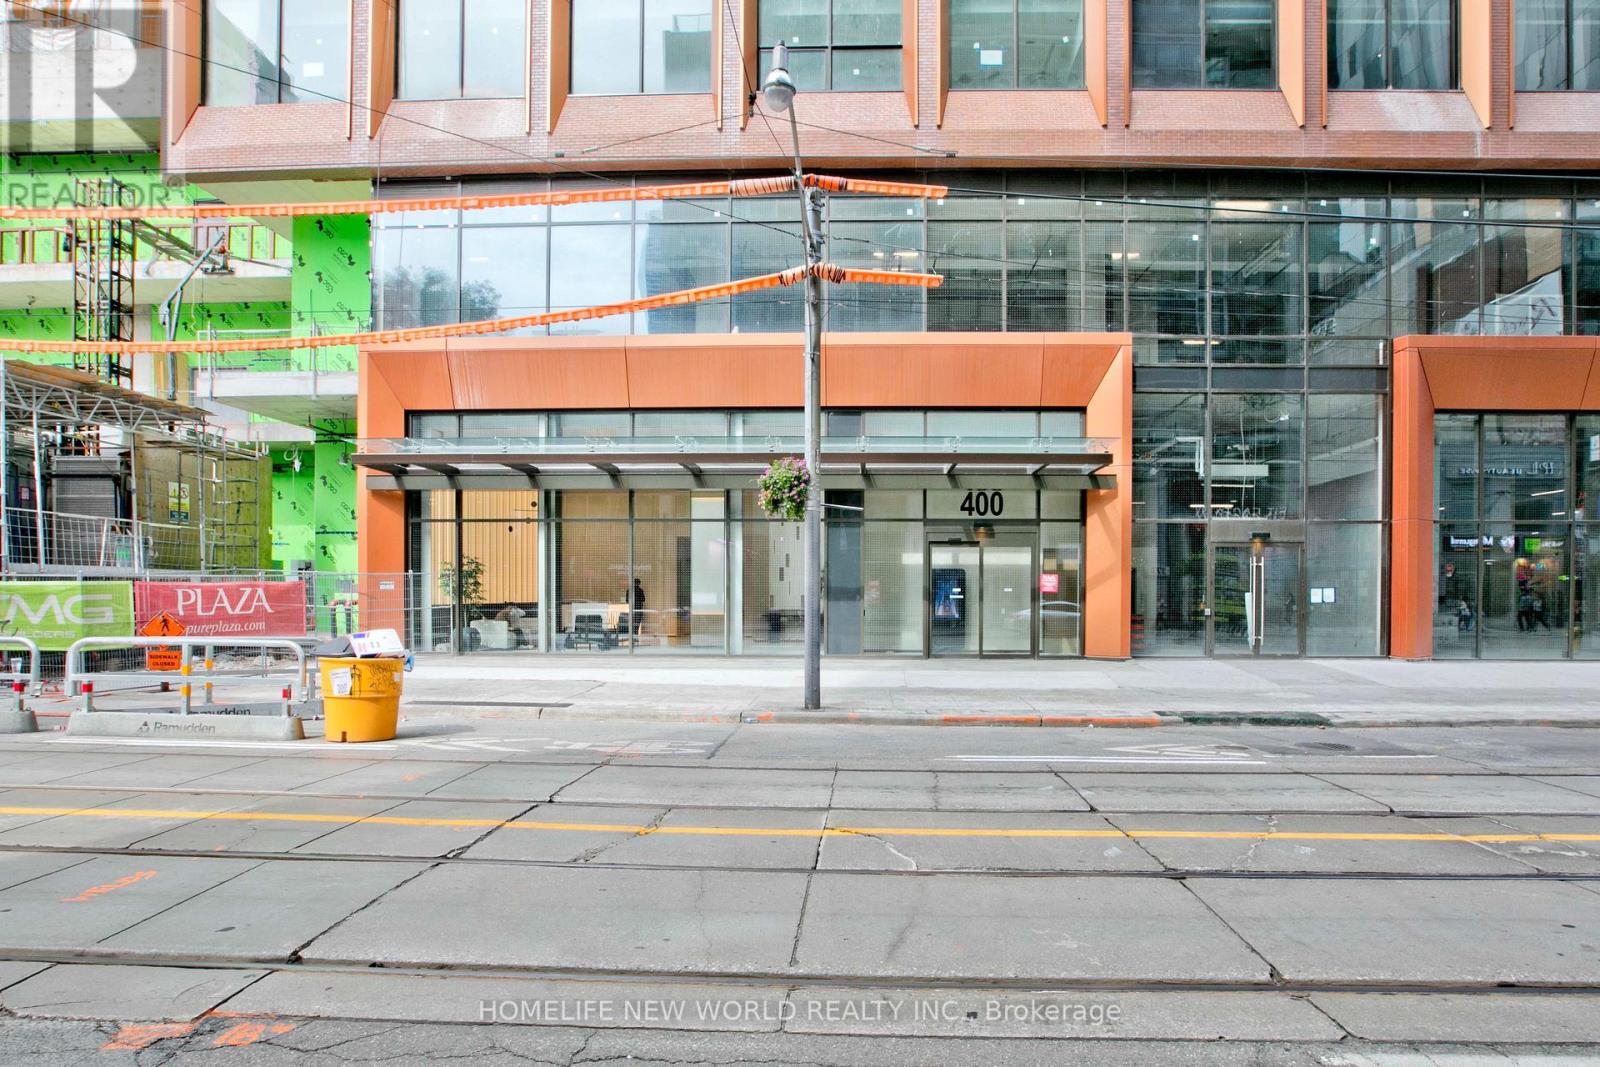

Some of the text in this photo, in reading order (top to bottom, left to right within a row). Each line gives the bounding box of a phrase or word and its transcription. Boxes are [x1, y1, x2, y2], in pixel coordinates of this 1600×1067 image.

[960, 491, 1004, 516] 400
[175, 587, 275, 616] PLAZA
[185, 619, 266, 636] pureplaza.com
[153, 720, 216, 735] Ramudden
